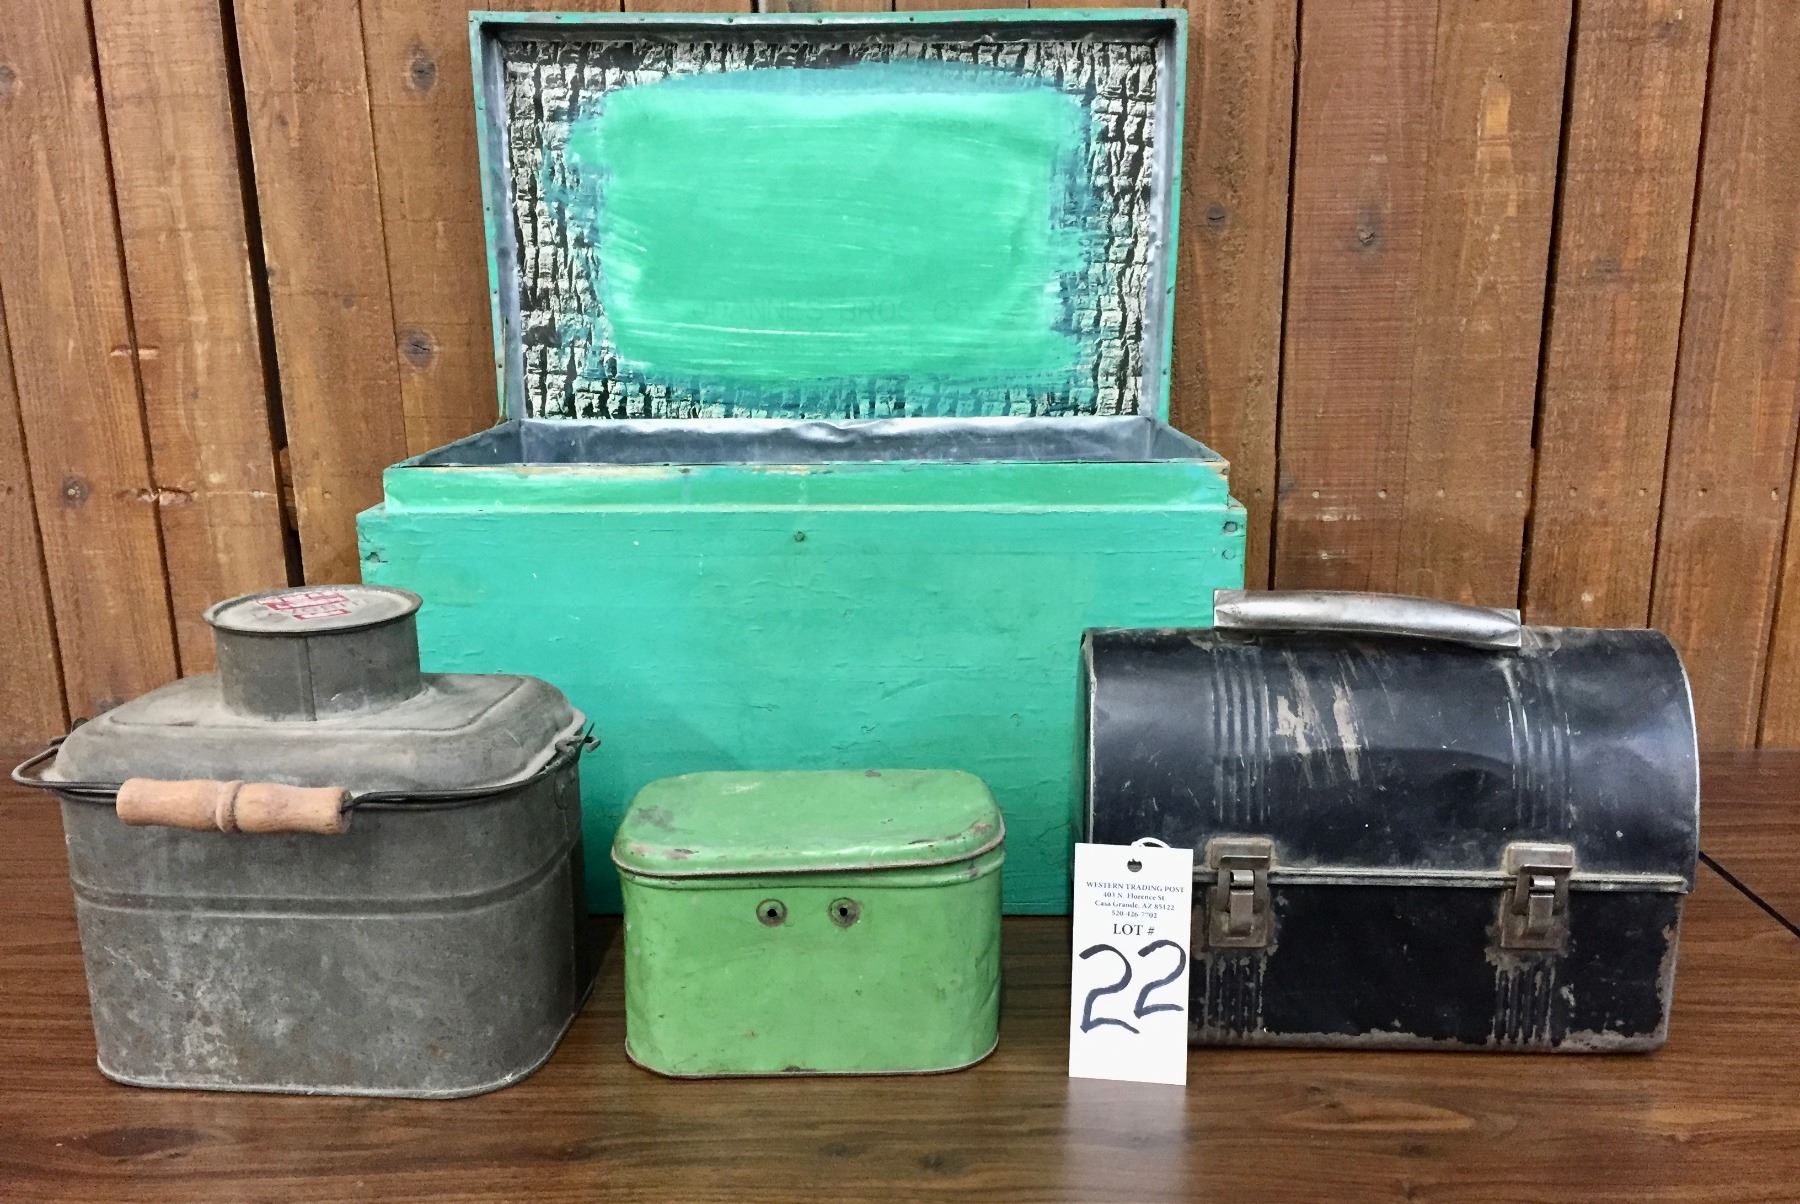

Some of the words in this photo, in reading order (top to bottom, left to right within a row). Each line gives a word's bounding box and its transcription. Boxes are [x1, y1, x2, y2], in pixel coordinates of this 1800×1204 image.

[1086, 881, 1124, 890] WESTERN
[1126, 883, 1163, 892] TRADING
[1164, 885, 1185, 893] POST
[1127, 892, 1156, 900] Florence
[1094, 899, 1111, 907] Casa
[1113, 923, 1143, 935] LOT
[1147, 926, 1155, 936] #
[1079, 939, 1187, 1034] 22
